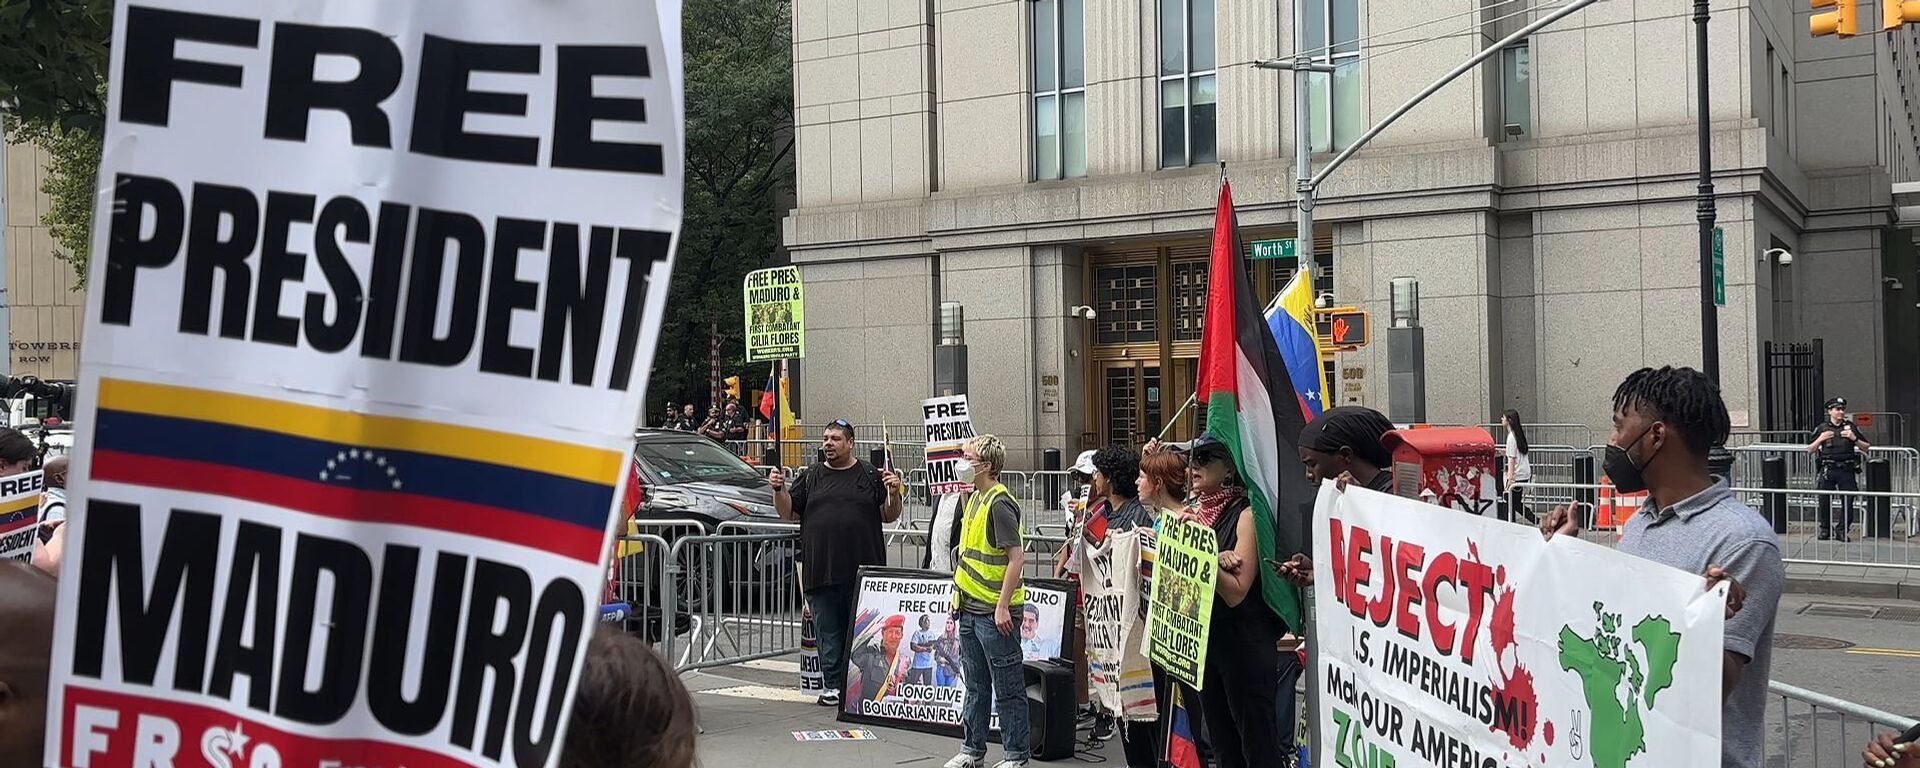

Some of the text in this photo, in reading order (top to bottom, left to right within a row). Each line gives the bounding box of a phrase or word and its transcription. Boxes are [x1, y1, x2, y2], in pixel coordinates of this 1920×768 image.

[119, 5, 665, 175] FREE
[1254, 241, 1293, 257] Worth St
[101, 173, 672, 391] PRESIDENT
[747, 268, 799, 288] FREE PRES.
[749, 286, 800, 304] MADURO &
[749, 321, 800, 335] FIRST COMBATANT
[751, 332, 799, 347] CILIA FLORES
[1182, 523, 1217, 557] PRES.
[1200, 561, 1211, 585] &
[864, 580, 894, 593] FREE
[890, 582, 948, 596] PRESIDENT
[898, 600, 926, 613] FREE
[72, 497, 585, 768] MADURO
[897, 684, 963, 703] LONG LIVE
[1382, 640, 1528, 741] IMPERIALISM!
[864, 701, 937, 721] BOLIVARIAN
[1361, 691, 1404, 747] OUR
